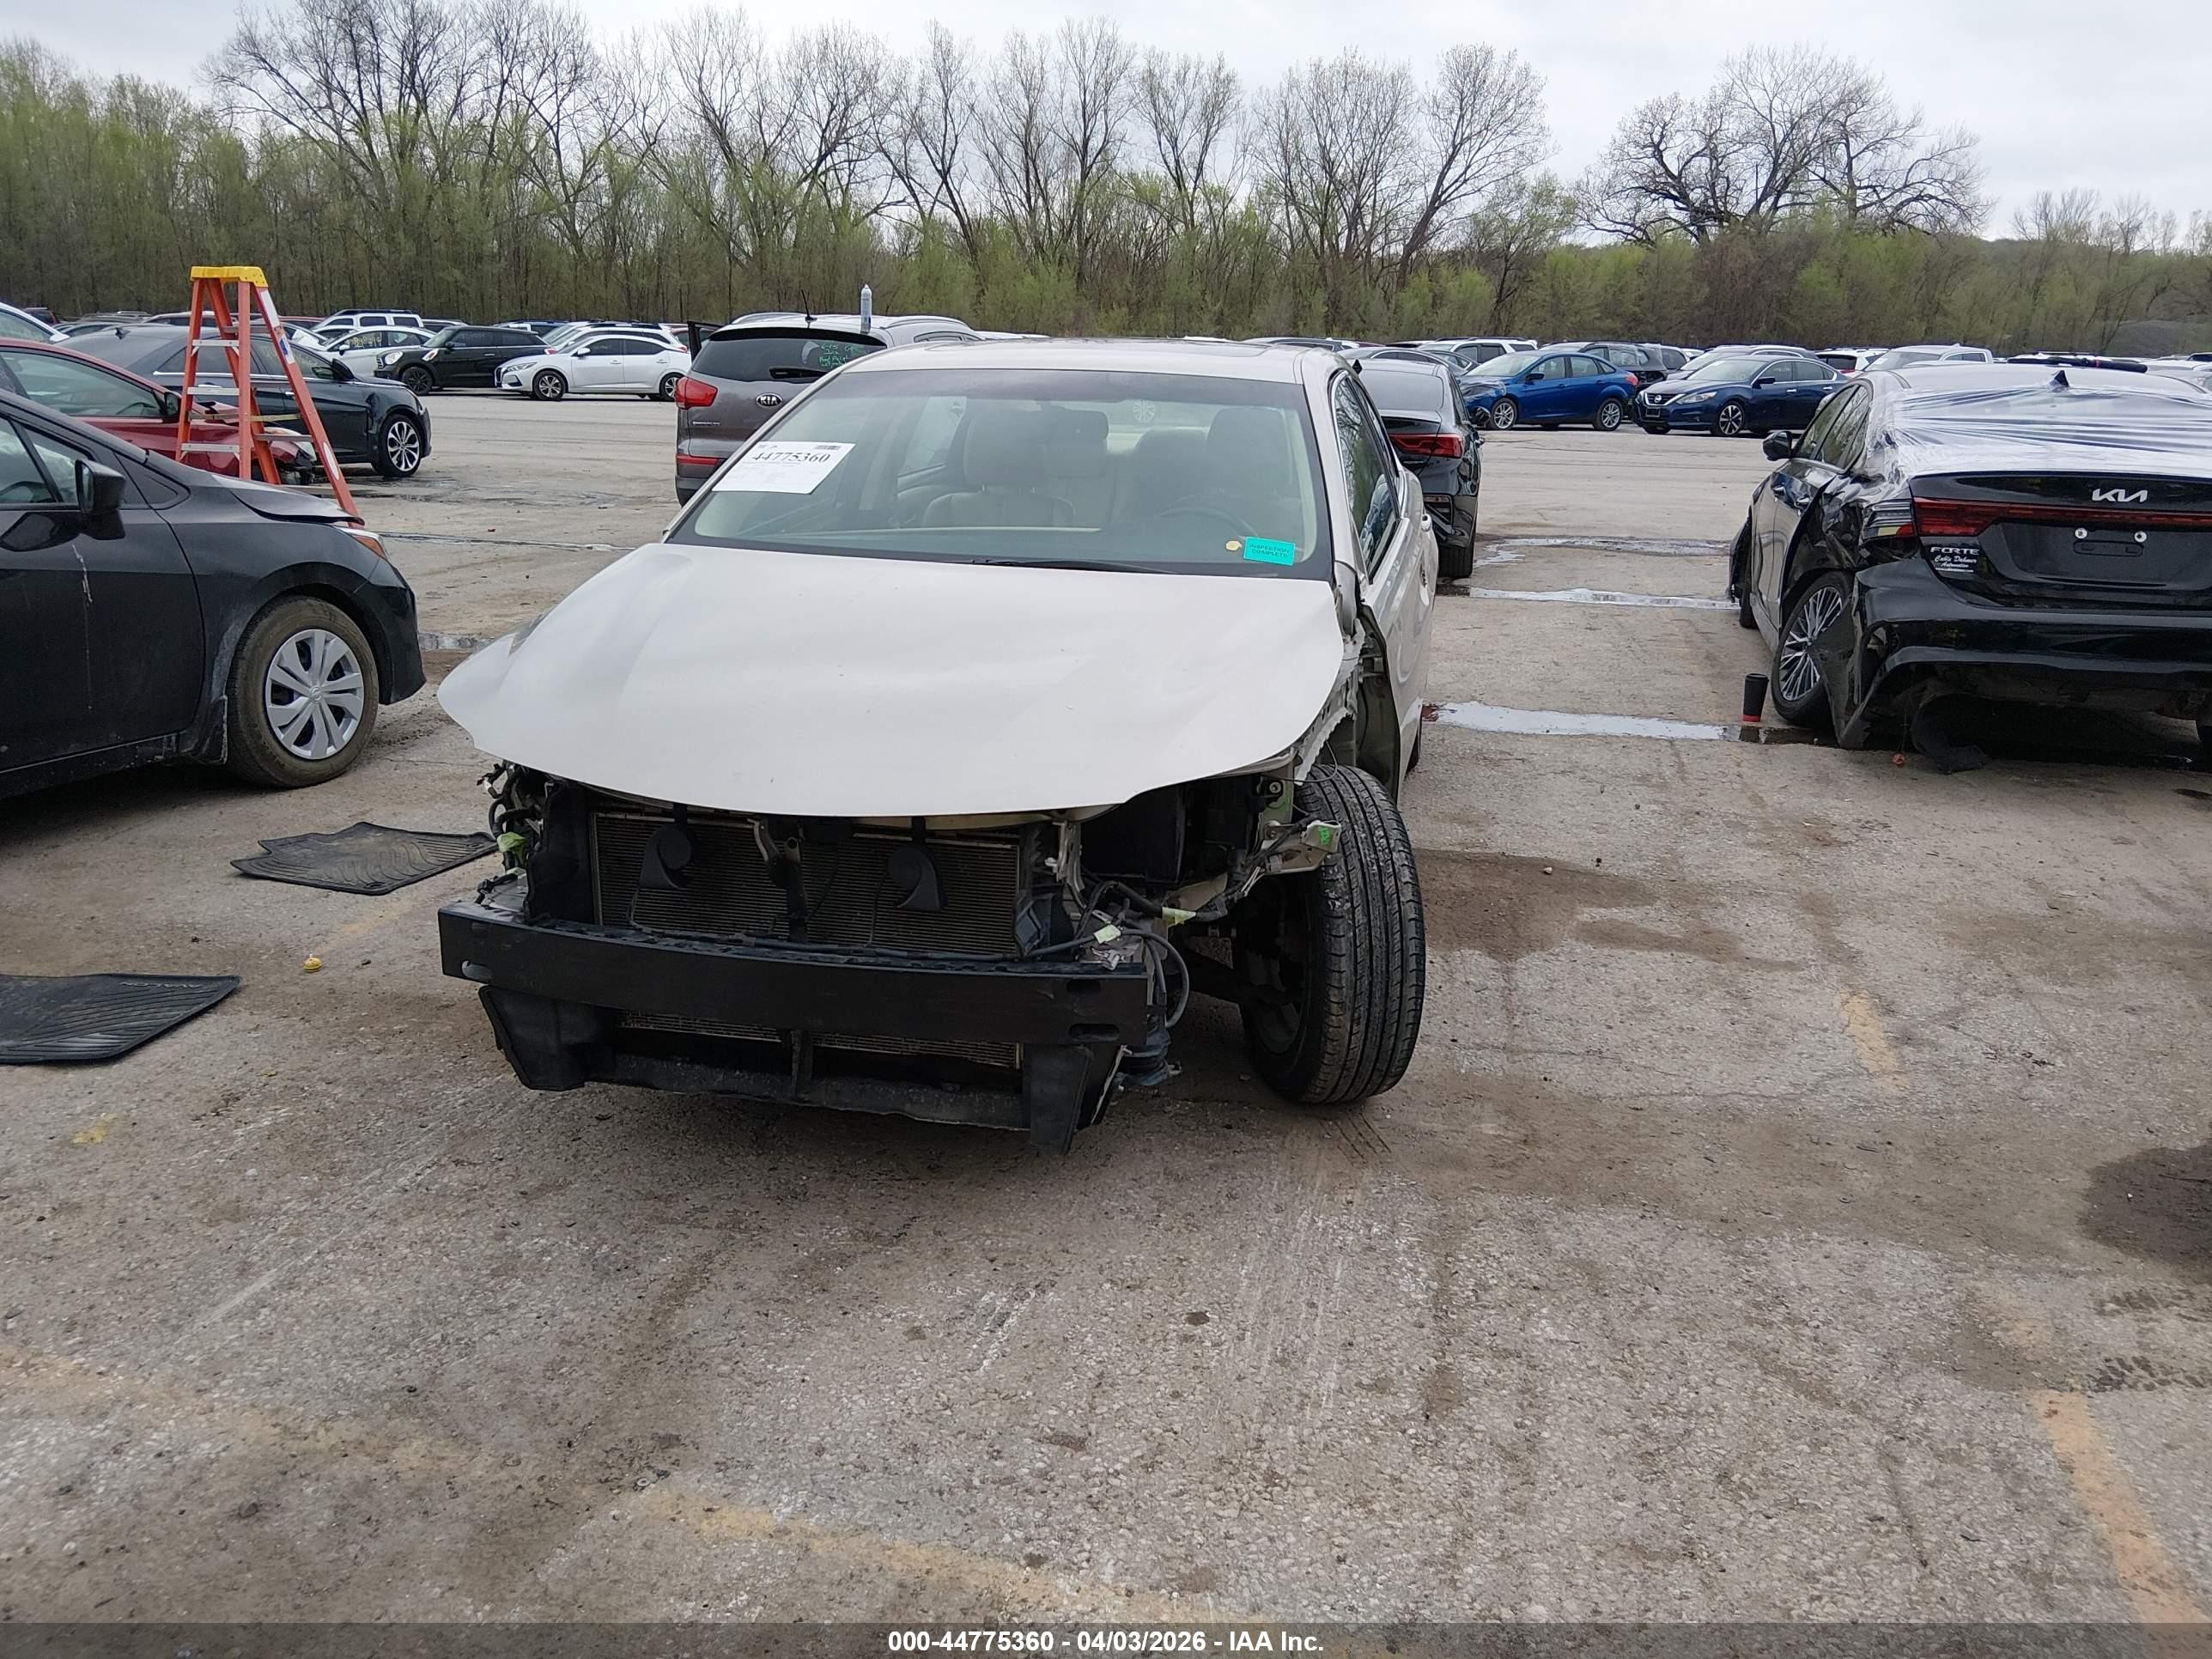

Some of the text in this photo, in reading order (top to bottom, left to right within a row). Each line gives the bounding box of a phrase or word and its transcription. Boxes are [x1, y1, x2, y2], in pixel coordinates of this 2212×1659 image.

[759, 396, 778, 405] KIA
[752, 452, 831, 463] 44775360
[1249, 544, 1290, 554] INSPECTION
[1251, 549, 1290, 558] COMPLETE
[1929, 546, 1980, 556] FORTE
